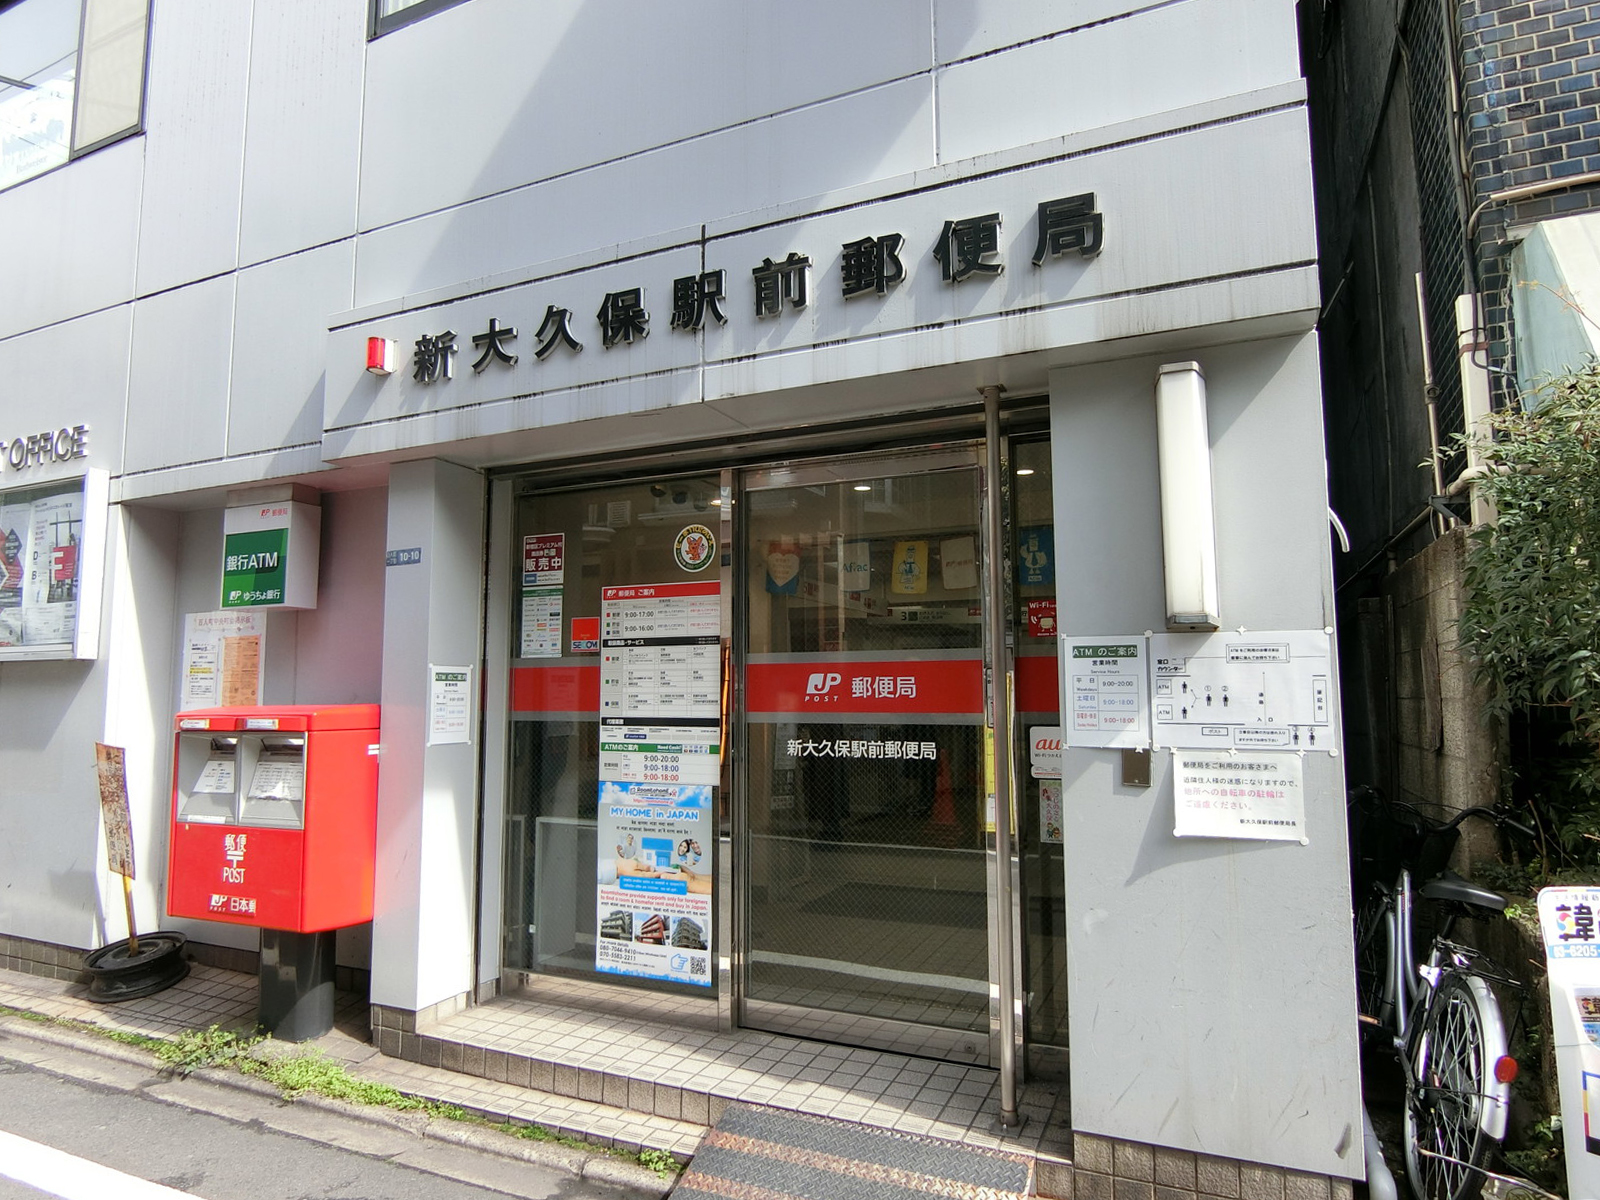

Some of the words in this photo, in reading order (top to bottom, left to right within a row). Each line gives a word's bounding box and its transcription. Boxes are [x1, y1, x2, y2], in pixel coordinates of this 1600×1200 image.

[412, 192, 1104, 386] 新大久保駅前郵便局
[9, 424, 90, 471] OFFICE
[226, 551, 278, 571] 銀行ATM
[400, 551, 420, 562] 10-10
[525, 557, 562, 571] 販売中
[243, 589, 281, 601] ゆうちょ銀行
[572, 641, 598, 649] SECOM
[1073, 648, 1093, 656] ATM
[1098, 647, 1137, 656] のご案内
[852, 677, 916, 698] 郵便局
[787, 739, 937, 760] 新大久保駅前郵便局
[1036, 739, 1061, 751] au
[644, 755, 679, 763] 9:00-20:00
[644, 764, 679, 772] 9:00-18:00
[1183, 761, 1278, 771] 郵便局をご利用のお客さまへ
[644, 773, 679, 781] 9:00-18:00
[1186, 800, 1252, 811] ご遠慮ください。
[625, 809, 652, 818] HOME
[656, 810, 664, 818] in
[667, 811, 699, 820] JAPAN
[224, 834, 247, 852] 郵便
[223, 867, 246, 884] POST
